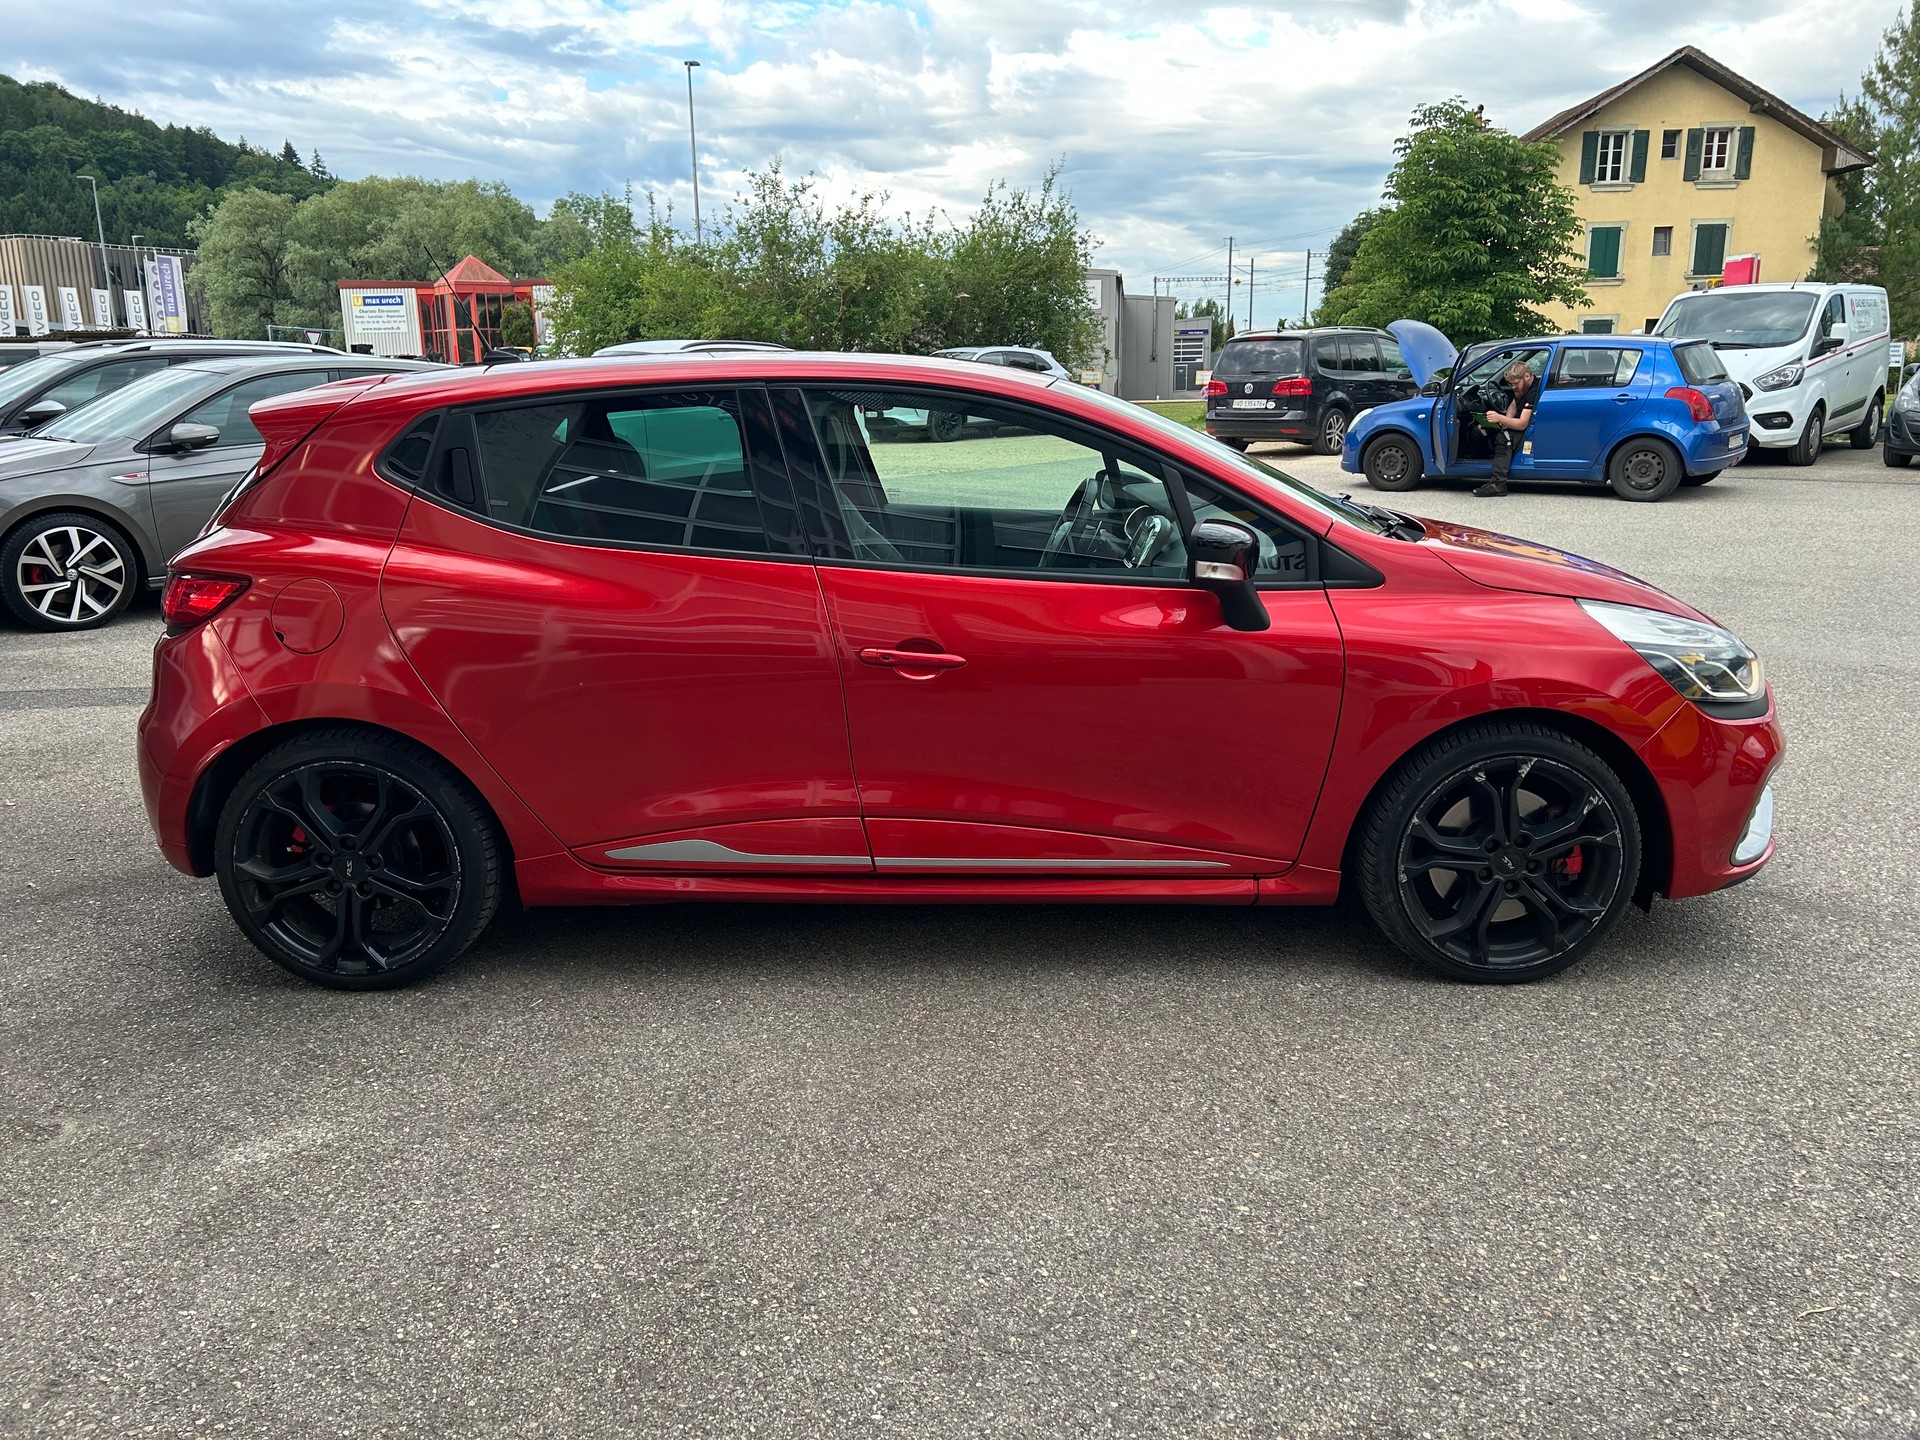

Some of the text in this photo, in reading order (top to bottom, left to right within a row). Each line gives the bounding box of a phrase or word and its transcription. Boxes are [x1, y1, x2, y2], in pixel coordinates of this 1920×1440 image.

[160, 263, 173, 290] urech
[0, 291, 10, 335] IVECO
[31, 291, 45, 334] IVECO
[67, 293, 80, 330] VECO
[99, 295, 110, 329] VECO
[132, 296, 143, 330] VECO
[166, 292, 176, 313] max
[381, 296, 401, 304] urech
